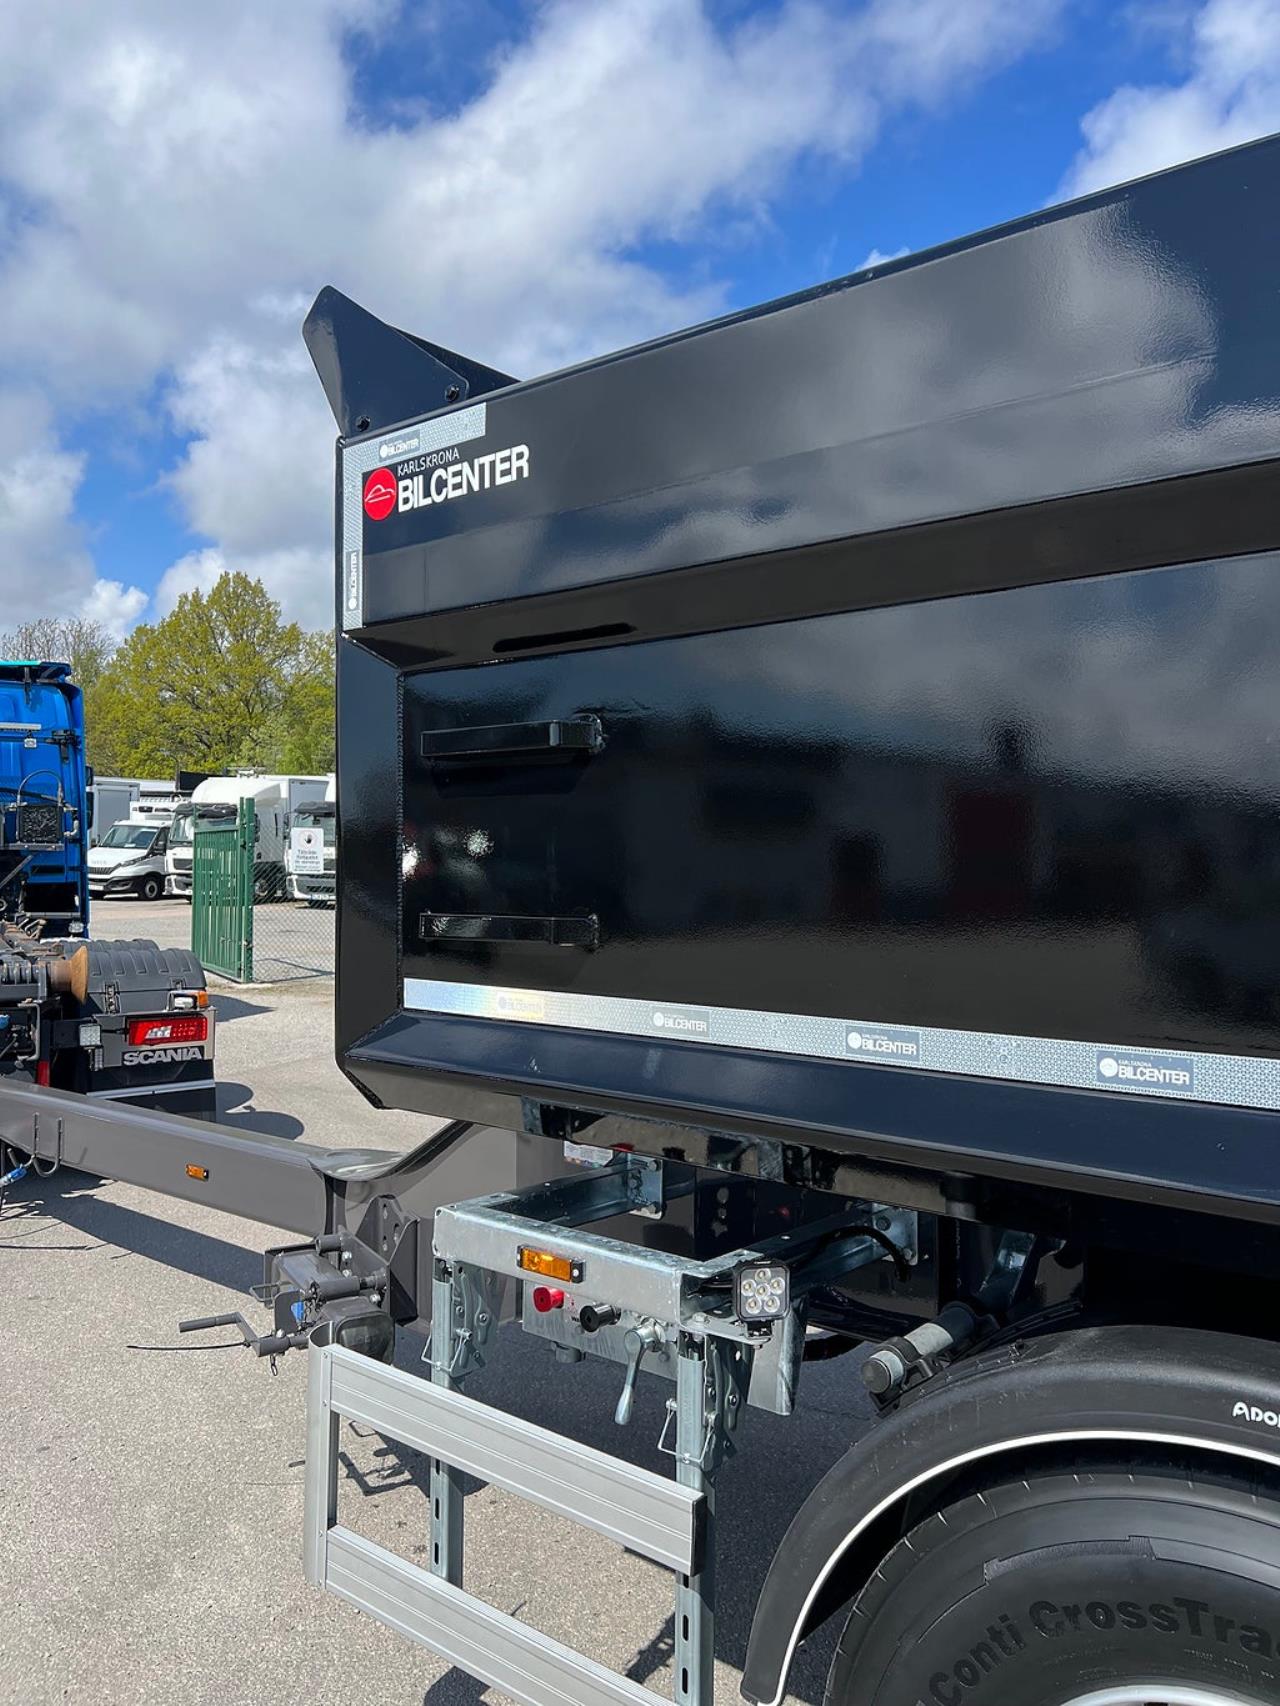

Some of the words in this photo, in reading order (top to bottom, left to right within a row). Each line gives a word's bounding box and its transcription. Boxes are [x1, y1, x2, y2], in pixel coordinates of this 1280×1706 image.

[397, 447, 460, 477] KARLSKRONA
[398, 444, 530, 512] BILCENTER
[664, 1016, 707, 1032] BILCENTER
[123, 1046, 203, 1066] SCANIA
[861, 1038, 917, 1056] BILCENTER
[1118, 1065, 1190, 1086] BILCENTER
[929, 1613, 1026, 1706] Conti
[1028, 1596, 1280, 1661] CrossTra
